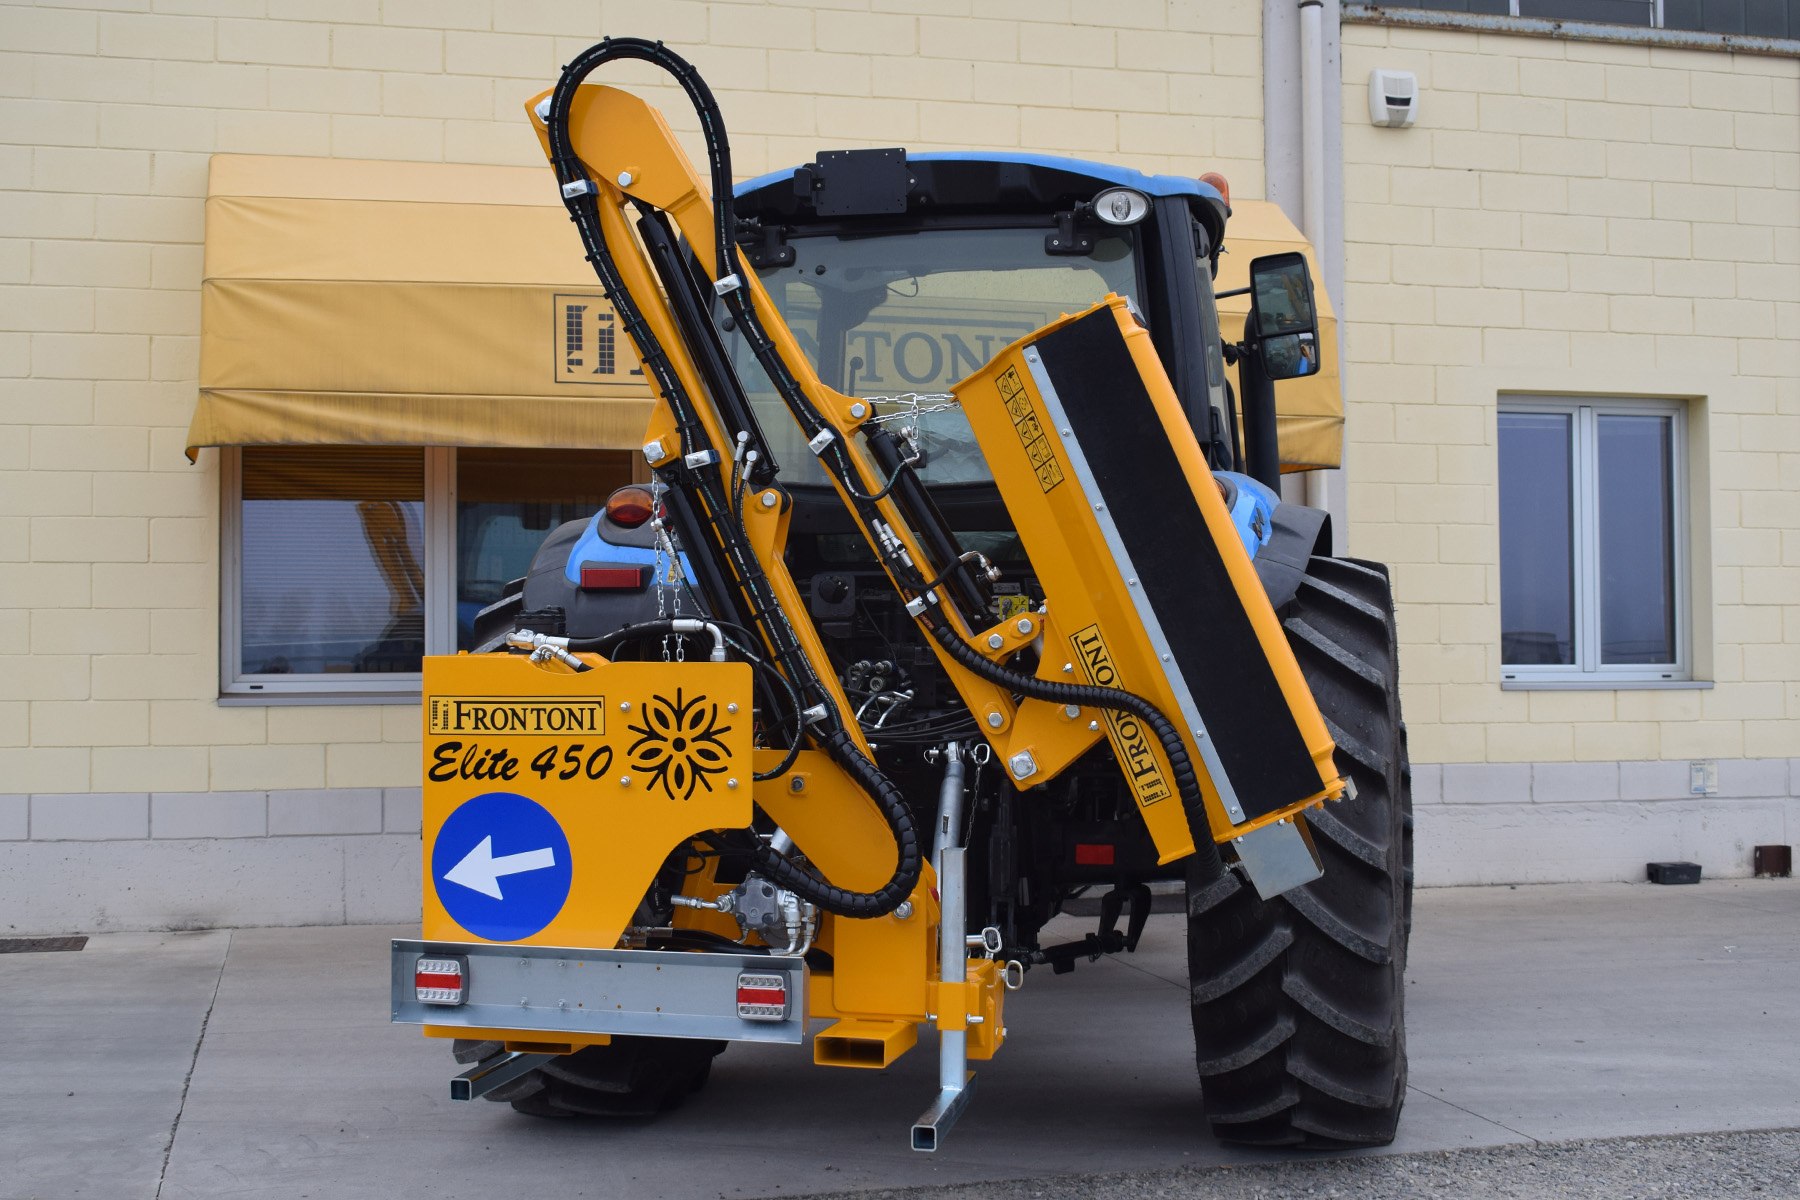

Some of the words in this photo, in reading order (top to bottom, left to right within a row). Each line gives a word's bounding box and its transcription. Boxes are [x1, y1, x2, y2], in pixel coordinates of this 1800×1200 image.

[453, 700, 602, 731] FRONTONI
[1077, 632, 1158, 782] FRONONI
[428, 741, 519, 782] Elite
[530, 744, 613, 780] 450
